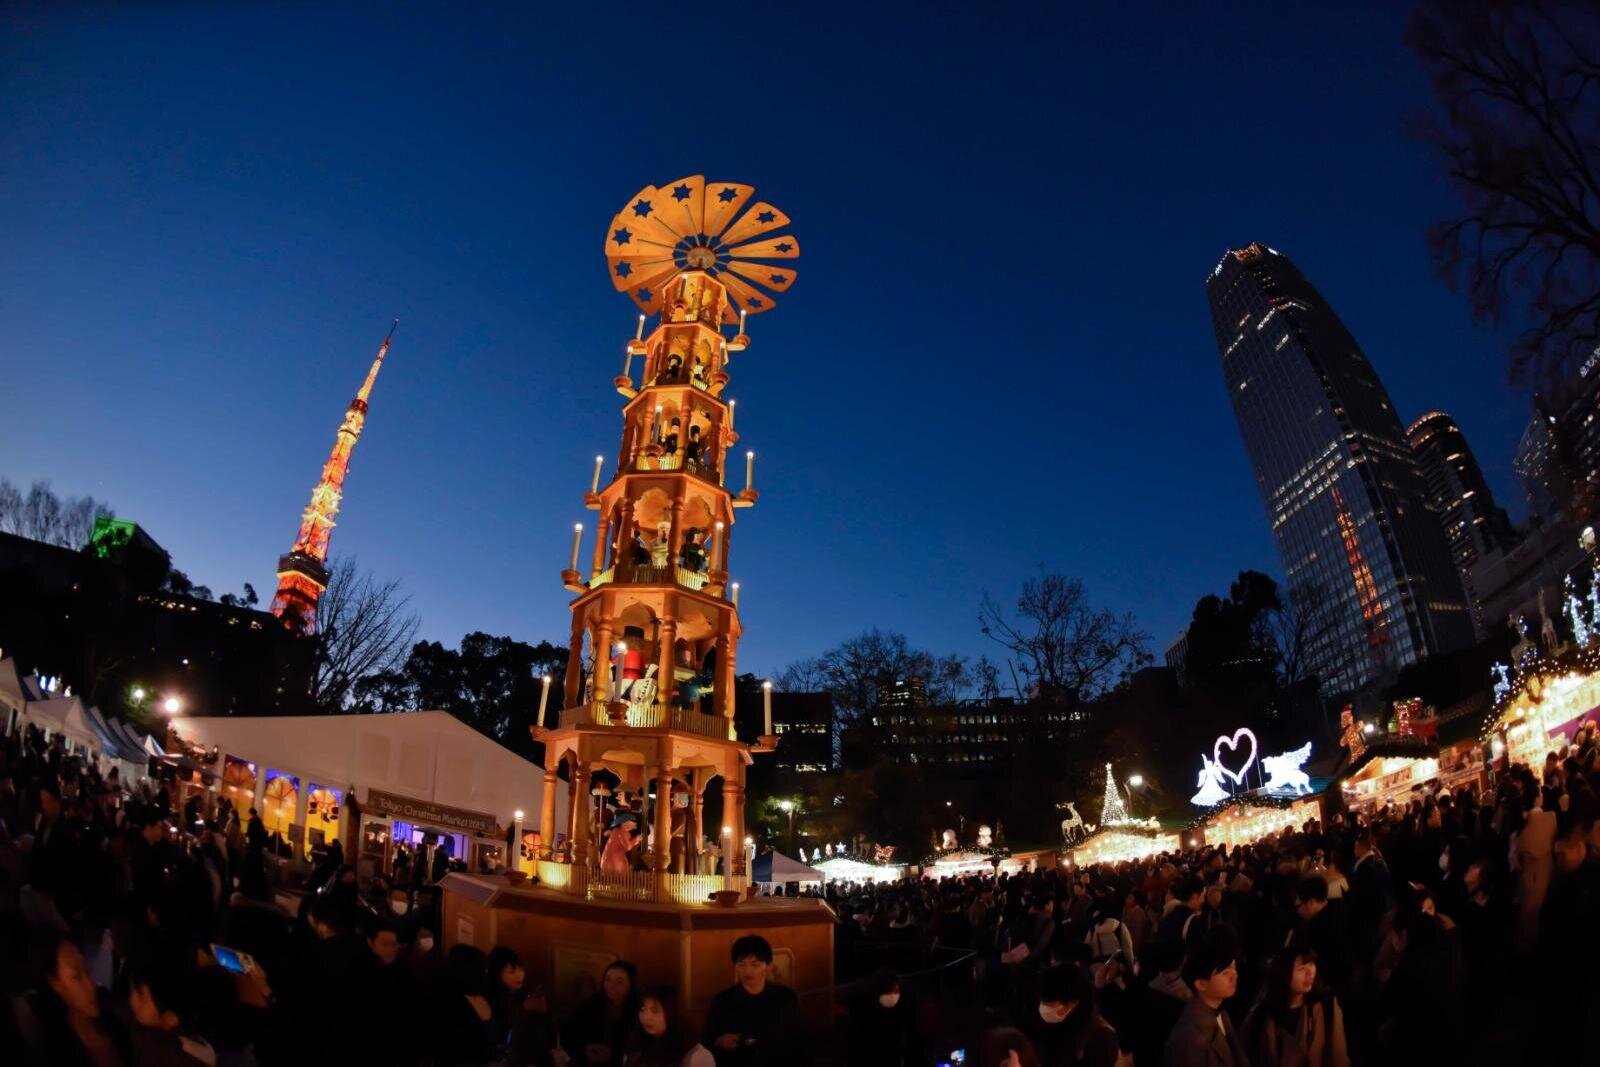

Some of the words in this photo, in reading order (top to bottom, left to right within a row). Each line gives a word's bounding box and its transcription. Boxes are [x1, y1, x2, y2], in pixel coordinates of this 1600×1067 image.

[380, 798, 402, 812] Tokyo
[404, 805, 441, 821] Christmas
[441, 812, 467, 827] Market
